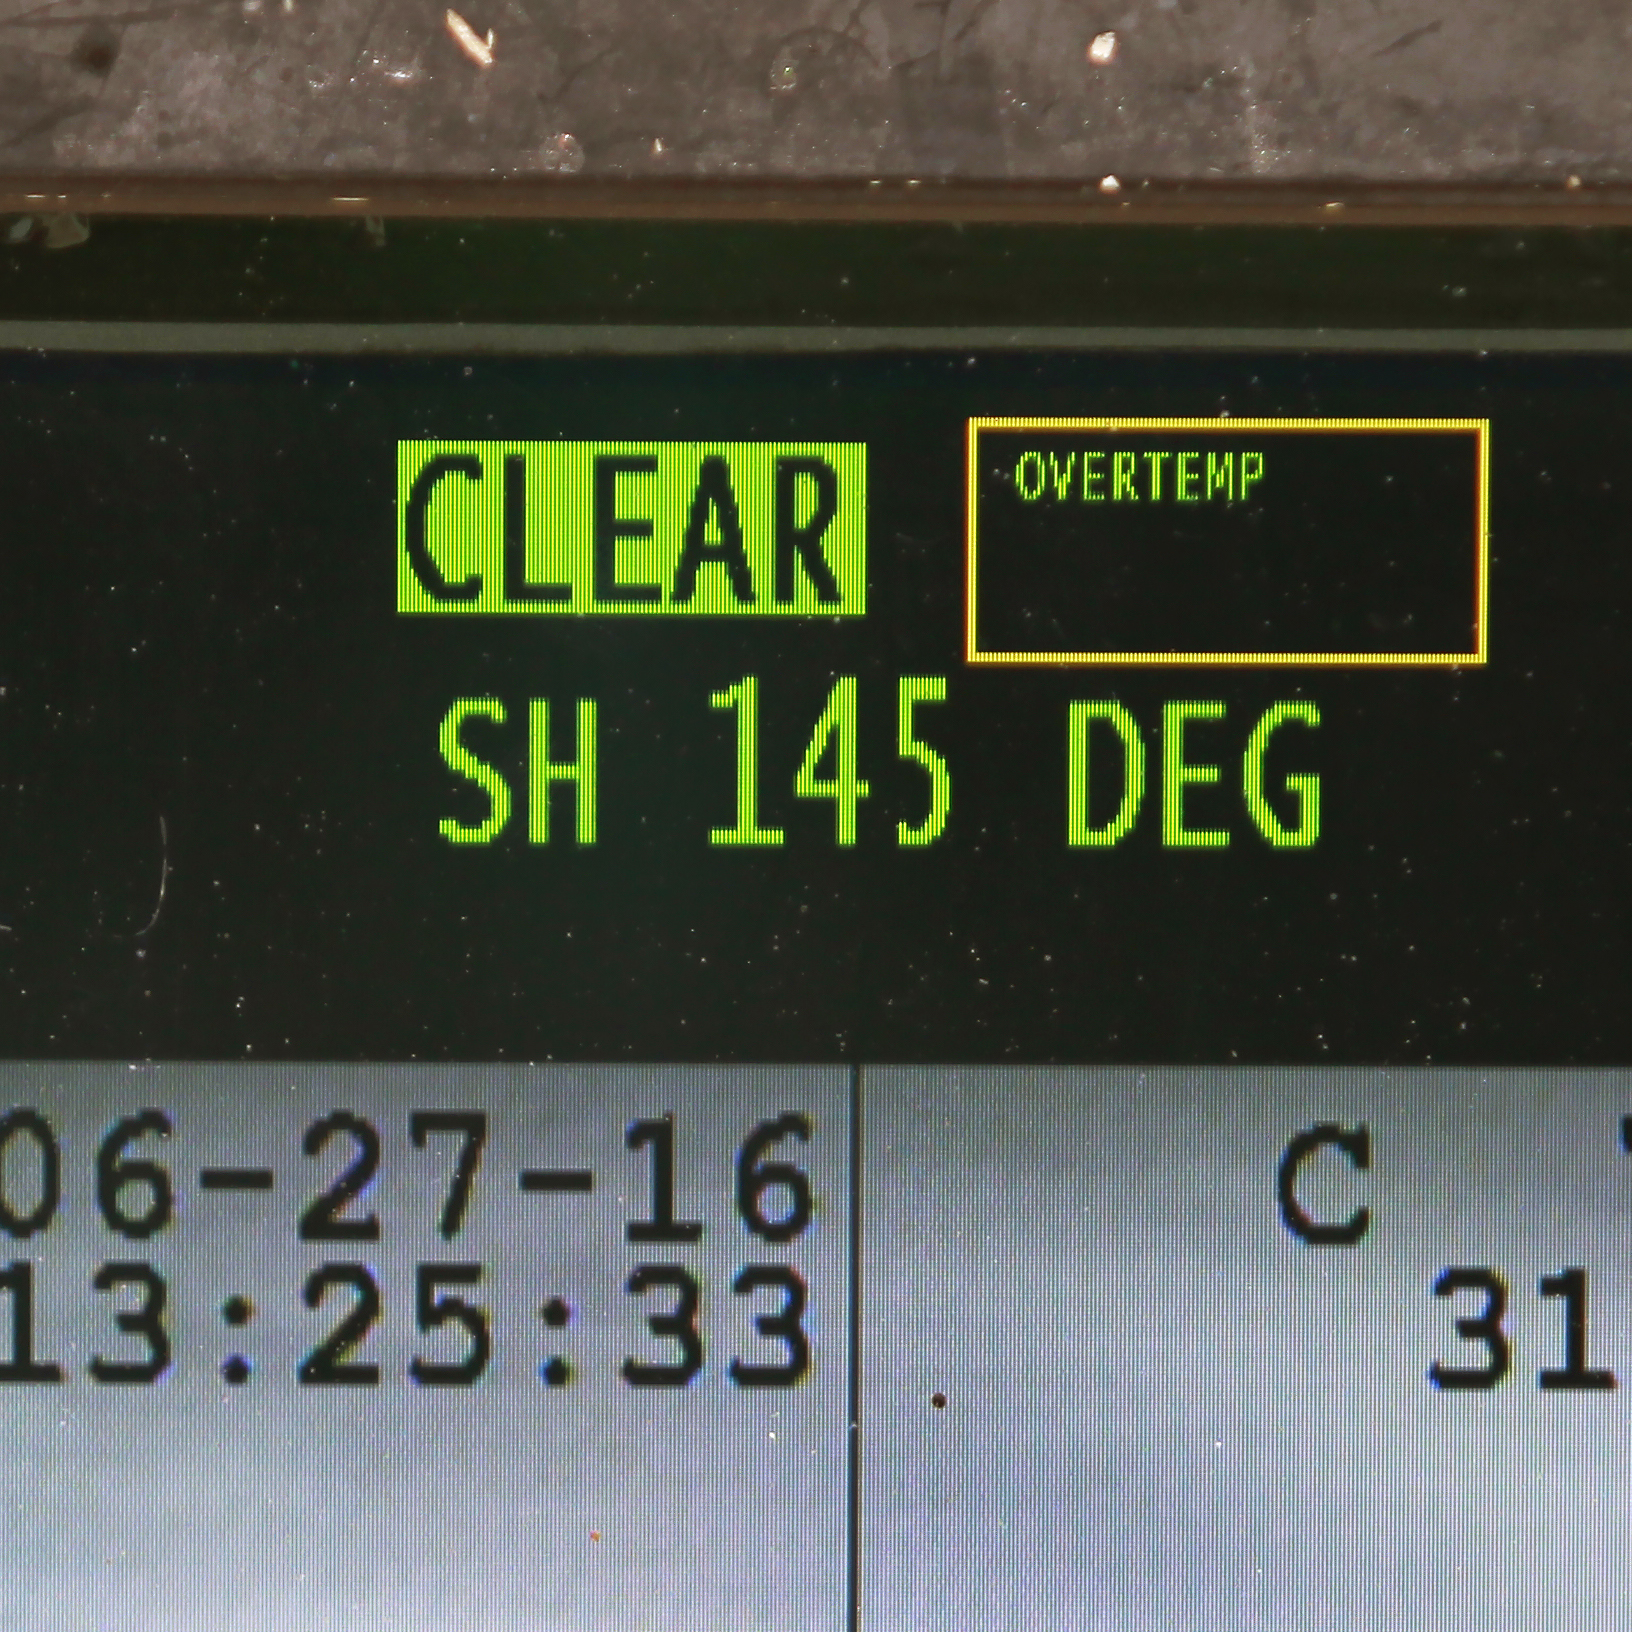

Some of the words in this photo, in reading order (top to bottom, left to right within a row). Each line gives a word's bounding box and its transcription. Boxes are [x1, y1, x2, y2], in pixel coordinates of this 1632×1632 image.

[402, 452, 844, 604] CLEAR
[1015, 452, 1263, 501] OVERTEMP
[439, 698, 597, 844] SH
[710, 677, 950, 845] 145
[1069, 700, 1320, 847] DEG
[1276, 1121, 1372, 1246] C
[1428, 1266, 1618, 1390] 31
